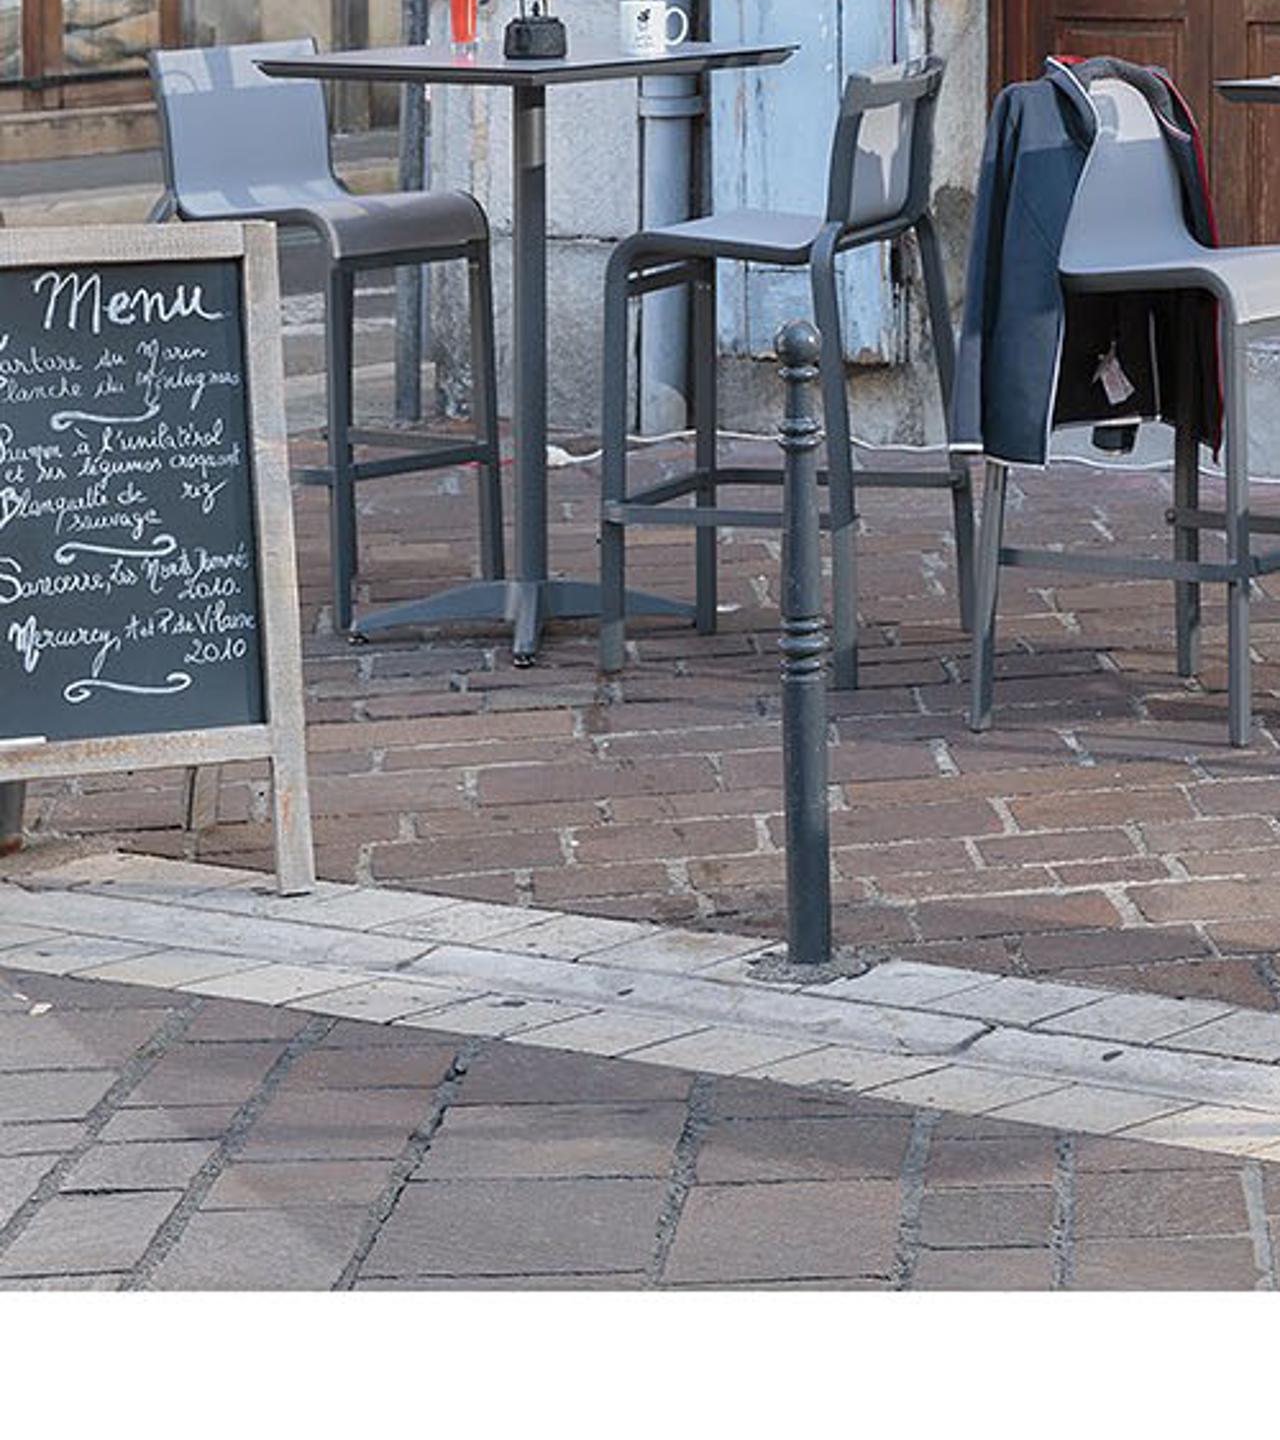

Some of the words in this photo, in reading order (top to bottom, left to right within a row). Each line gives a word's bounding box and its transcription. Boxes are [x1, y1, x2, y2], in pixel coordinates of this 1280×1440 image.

[34, 271, 229, 335] Menu
[0, 335, 83, 375] artare
[72, 427, 91, 457] à
[183, 637, 247, 664] 2010
